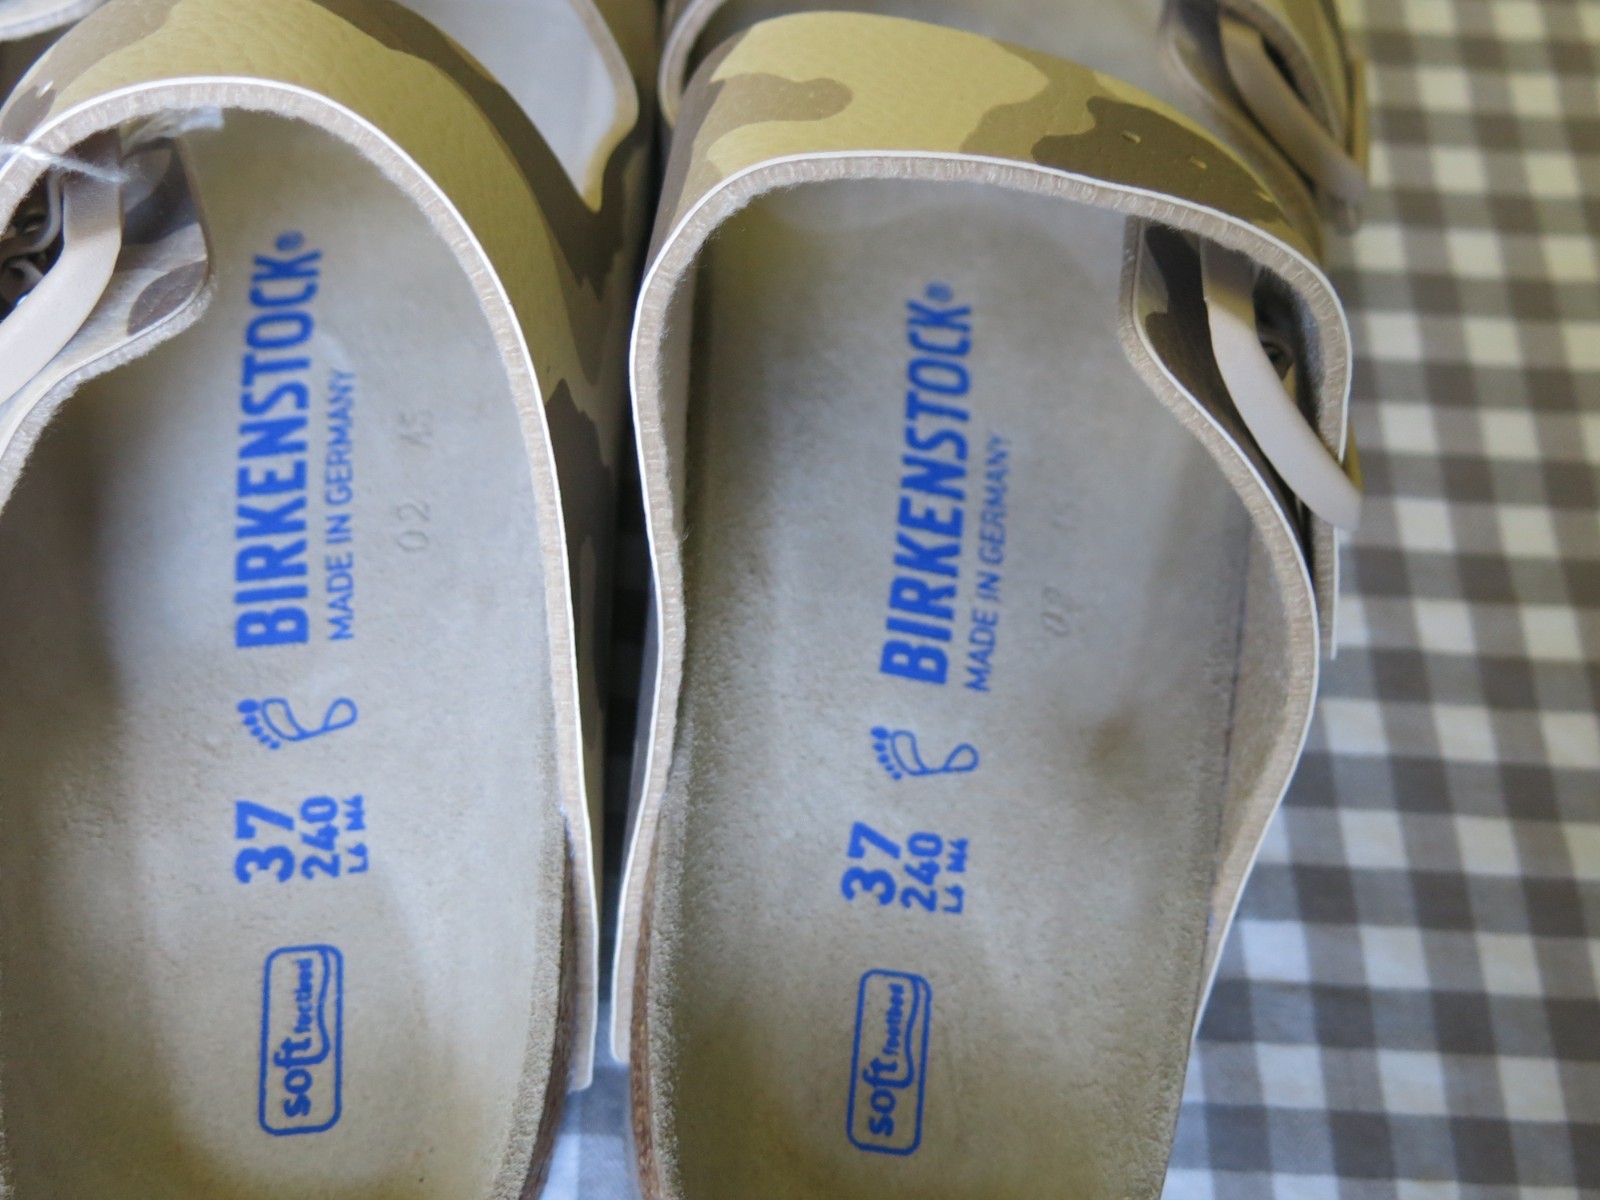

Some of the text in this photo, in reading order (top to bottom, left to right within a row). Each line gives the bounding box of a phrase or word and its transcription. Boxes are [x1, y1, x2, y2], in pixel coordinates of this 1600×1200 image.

[325, 368, 355, 641] MADE IN GERMANY
[963, 432, 1010, 693] MADE IN GERMANY
[234, 800, 296, 884] 37
[300, 795, 340, 880] 240
[840, 820, 901, 906] 37
[900, 831, 944, 913] 240
